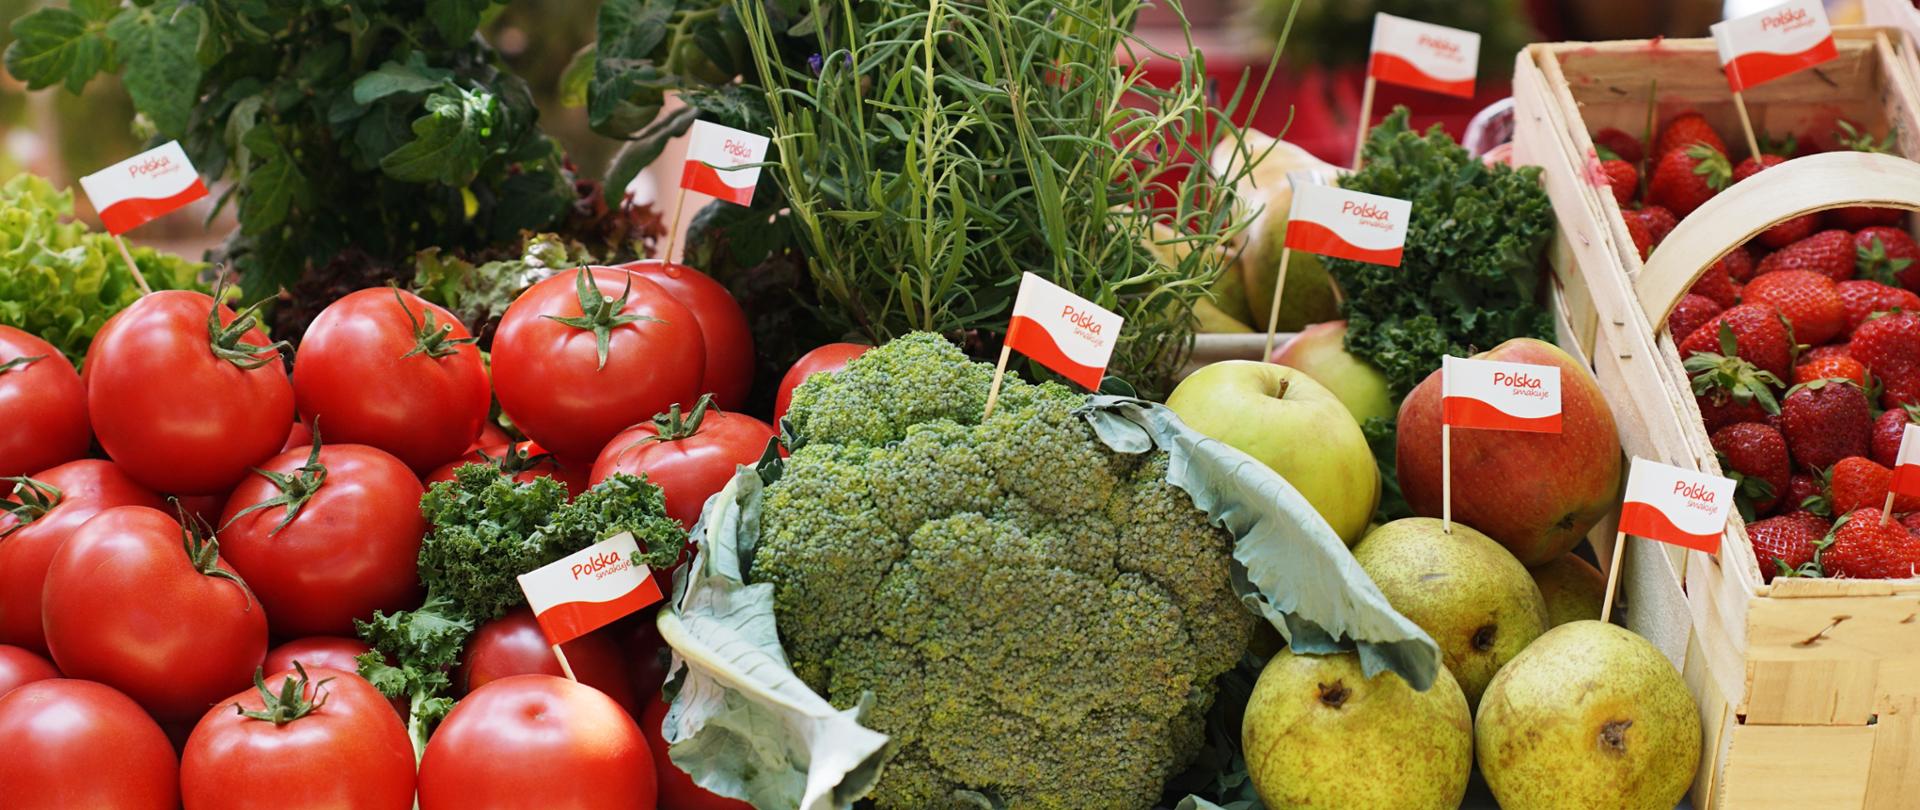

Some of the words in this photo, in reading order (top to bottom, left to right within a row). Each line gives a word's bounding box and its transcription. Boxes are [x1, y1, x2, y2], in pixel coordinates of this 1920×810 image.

[1341, 201, 1389, 220] Polska
[1061, 305, 1102, 335] Polska
[1493, 372, 1541, 388] Polska
[1512, 388, 1550, 399] smakuje
[1673, 480, 1715, 502] Polska
[571, 551, 620, 580] Polska
[595, 559, 632, 580] smakuje
